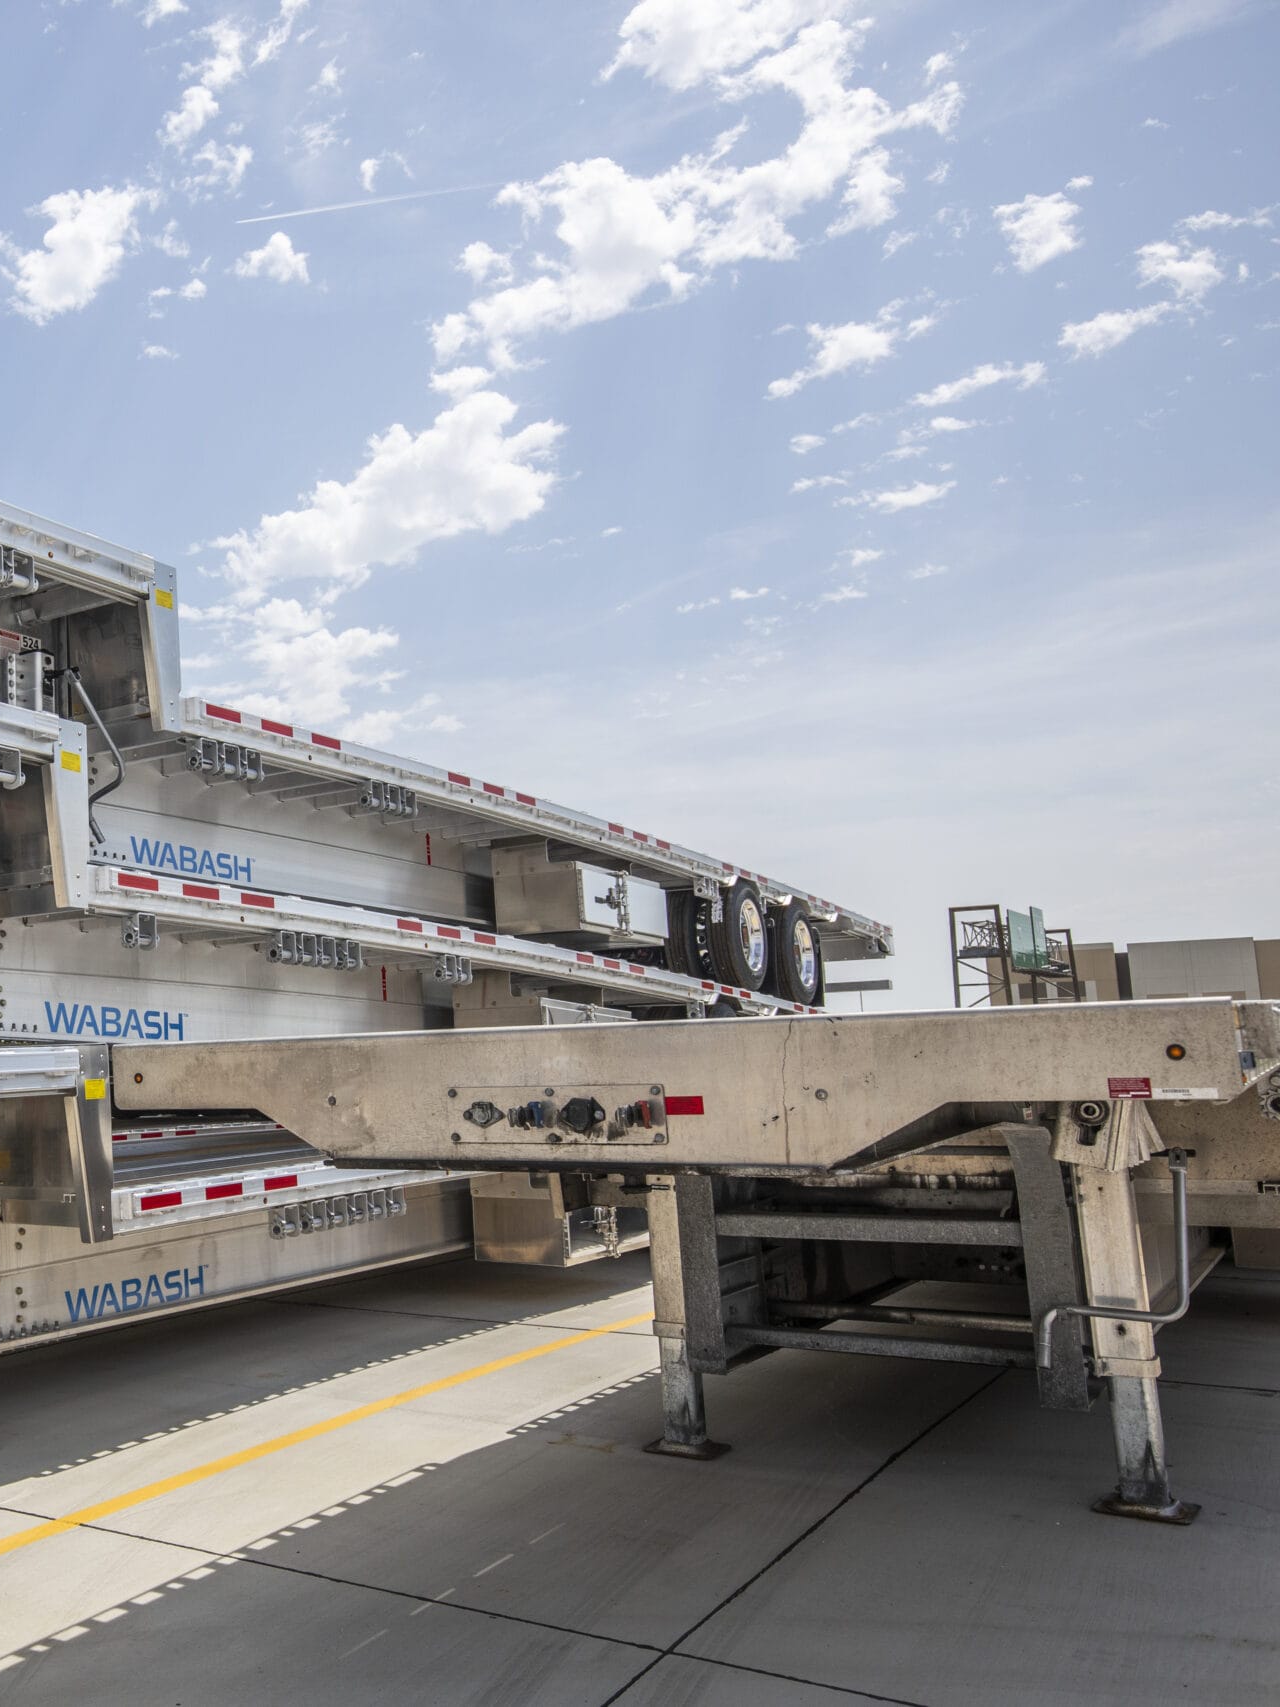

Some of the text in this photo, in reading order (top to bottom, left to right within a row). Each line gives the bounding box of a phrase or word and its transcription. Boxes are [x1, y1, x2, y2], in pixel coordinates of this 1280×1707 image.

[23, 637, 39, 649] 524
[130, 835, 252, 882] WABASH
[44, 1001, 184, 1041] WABASH
[64, 1265, 204, 1322] WABASH
